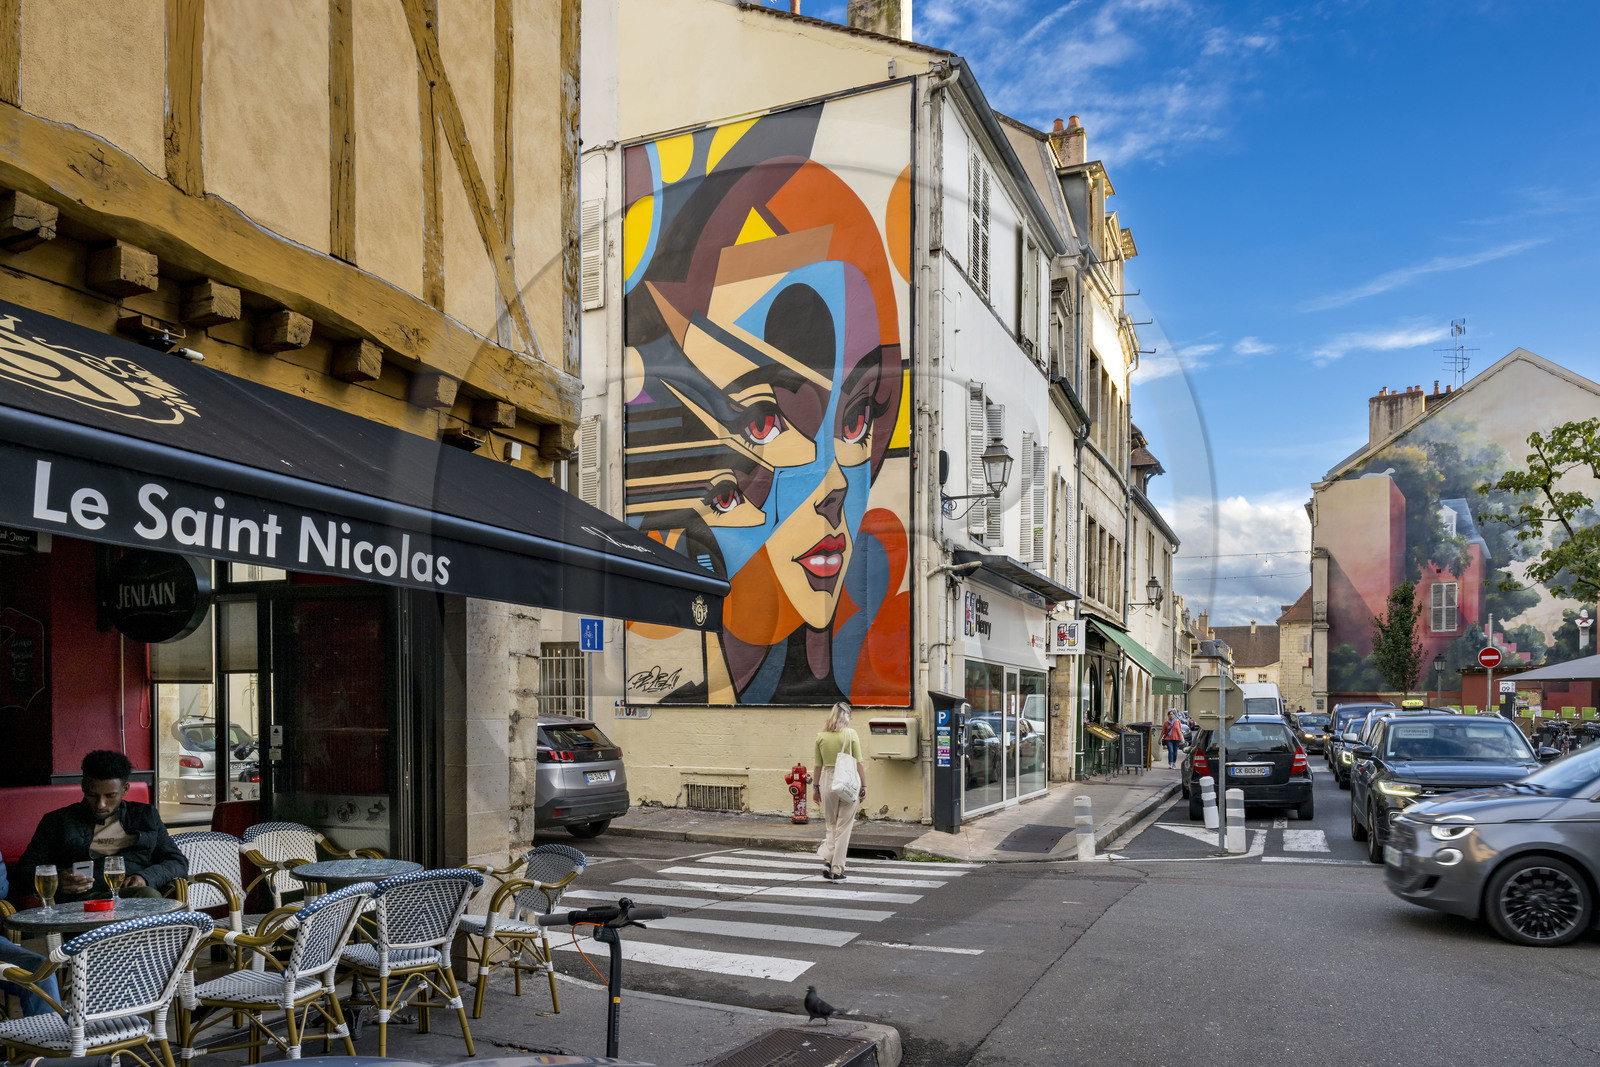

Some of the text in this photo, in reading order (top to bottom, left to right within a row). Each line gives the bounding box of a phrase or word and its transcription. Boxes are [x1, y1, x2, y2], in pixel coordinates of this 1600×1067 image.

[33, 460, 451, 586] Le Saint Nicolas
[115, 580, 176, 610] JENLAIN
[975, 595, 989, 616] chez
[975, 613, 992, 641] Henry
[938, 711, 947, 724] P
